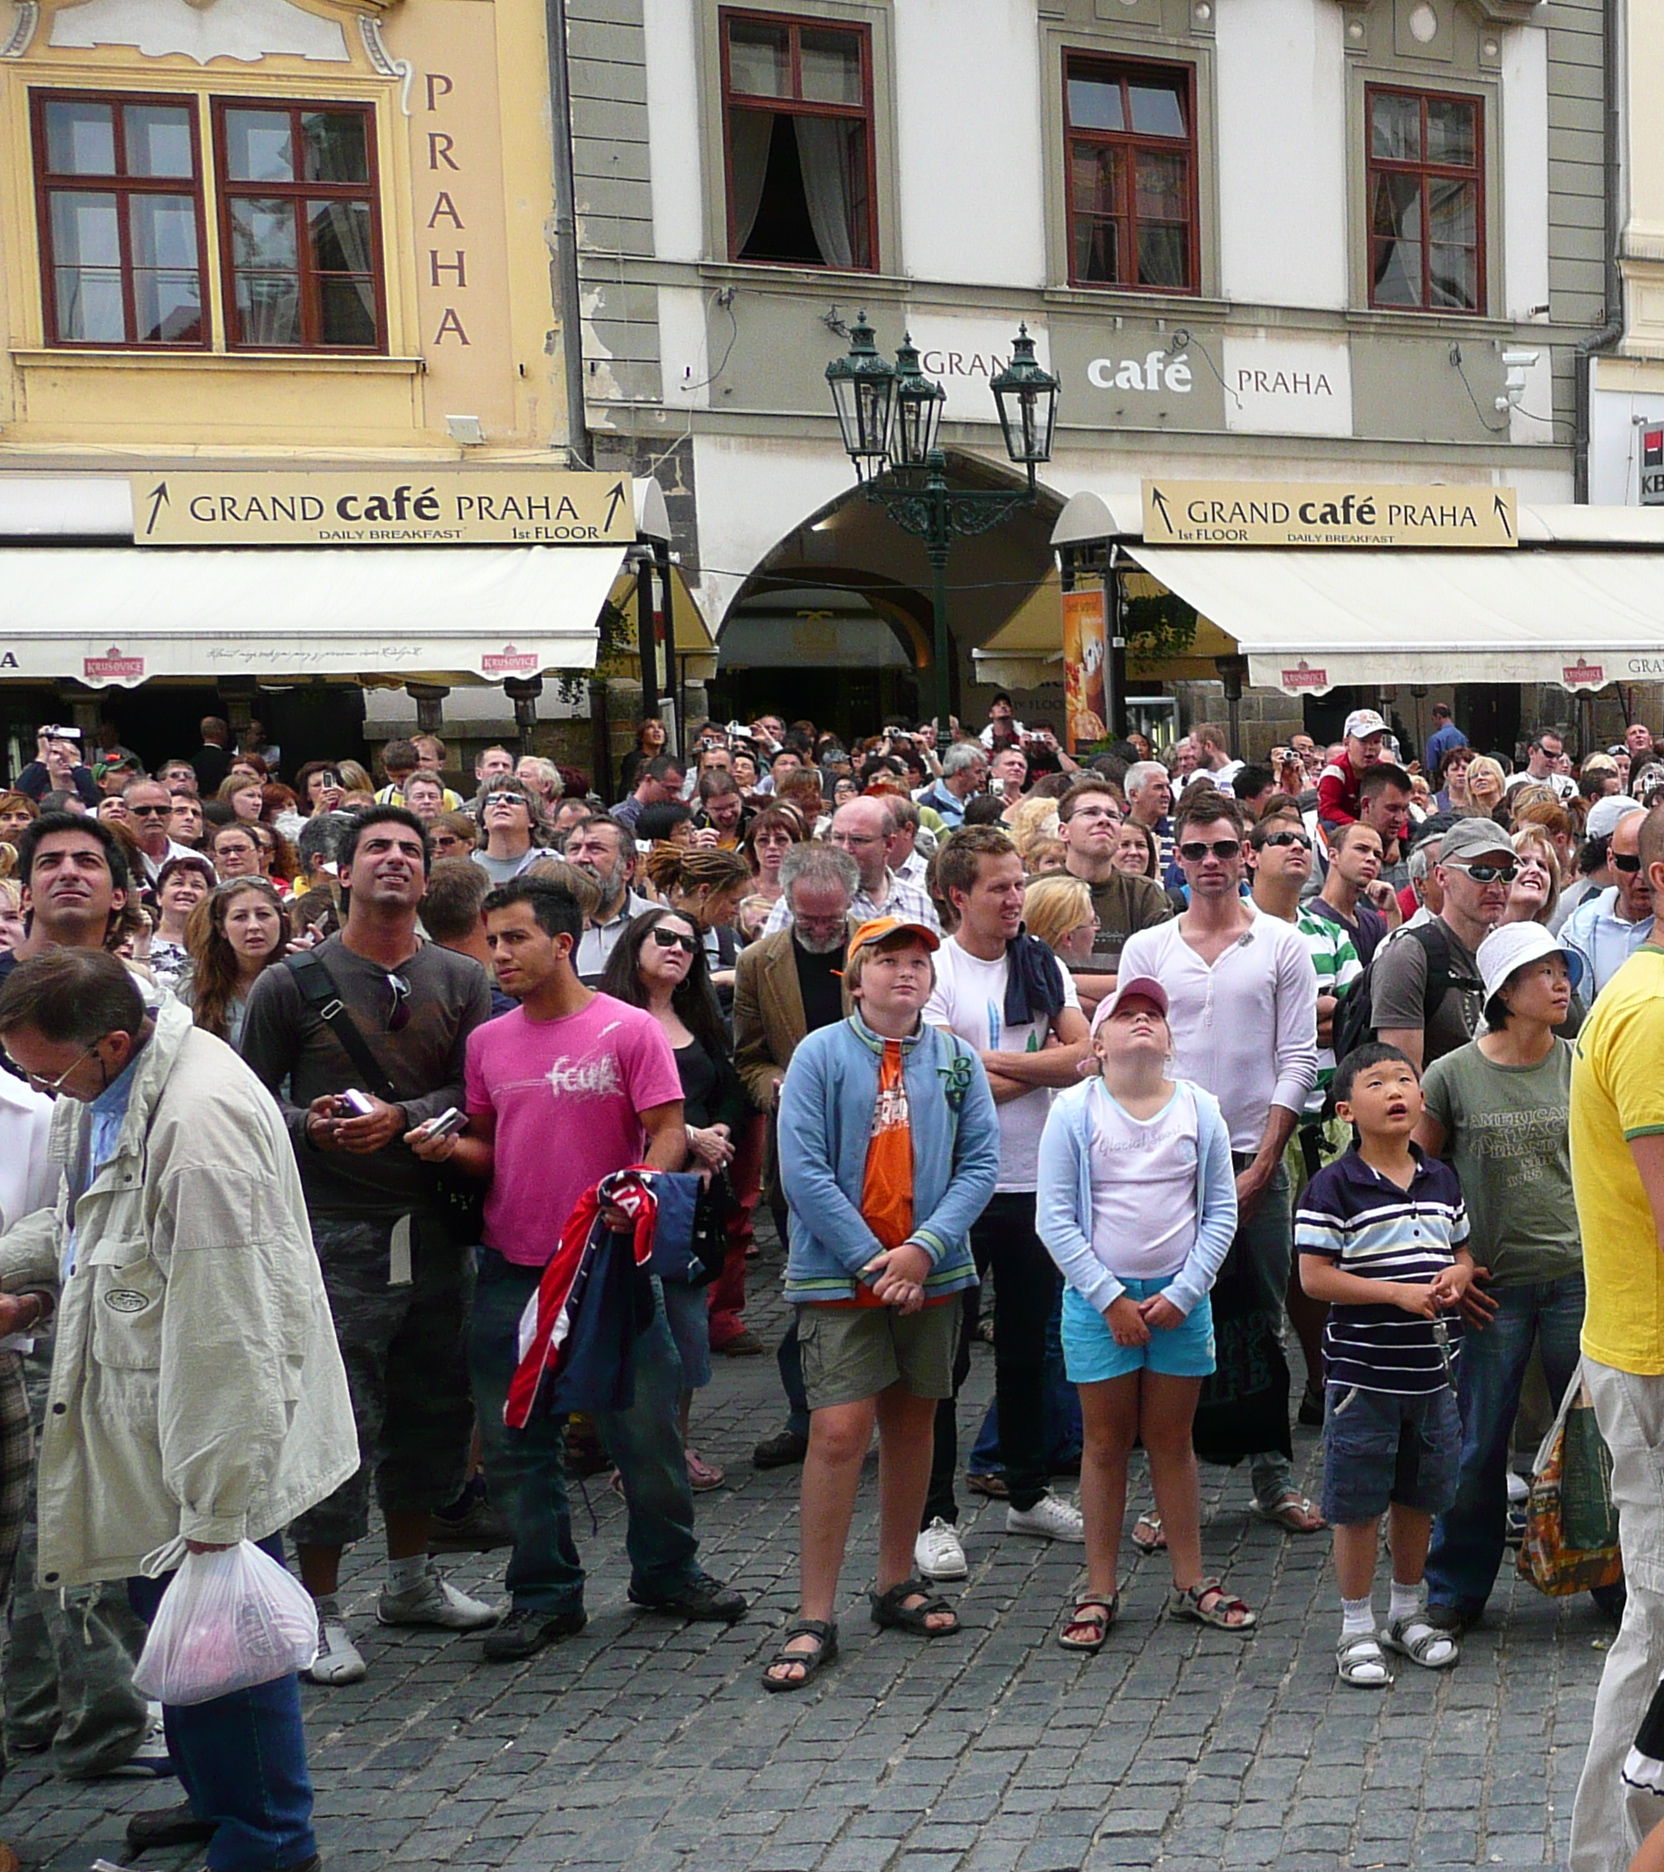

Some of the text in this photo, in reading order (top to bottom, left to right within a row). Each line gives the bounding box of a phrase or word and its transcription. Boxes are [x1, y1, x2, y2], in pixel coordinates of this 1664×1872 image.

[424, 73, 471, 346] PRAHA
[923, 349, 1333, 396] GRAN café PRAHA
[189, 486, 580, 522] GRAND café PRAHA
[1187, 494, 1478, 528] GRAND café PRAHA
[318, 529, 463, 541] DAILY BREAKFAST
[510, 525, 600, 540] 1st FLOOR
[1177, 528, 1250, 541] 1st FLOOR
[1286, 533, 1397, 545] DAILY BREAKFAST
[545, 1054, 625, 1098] fcuk
[1469, 1117, 1568, 1159] VINTAG
